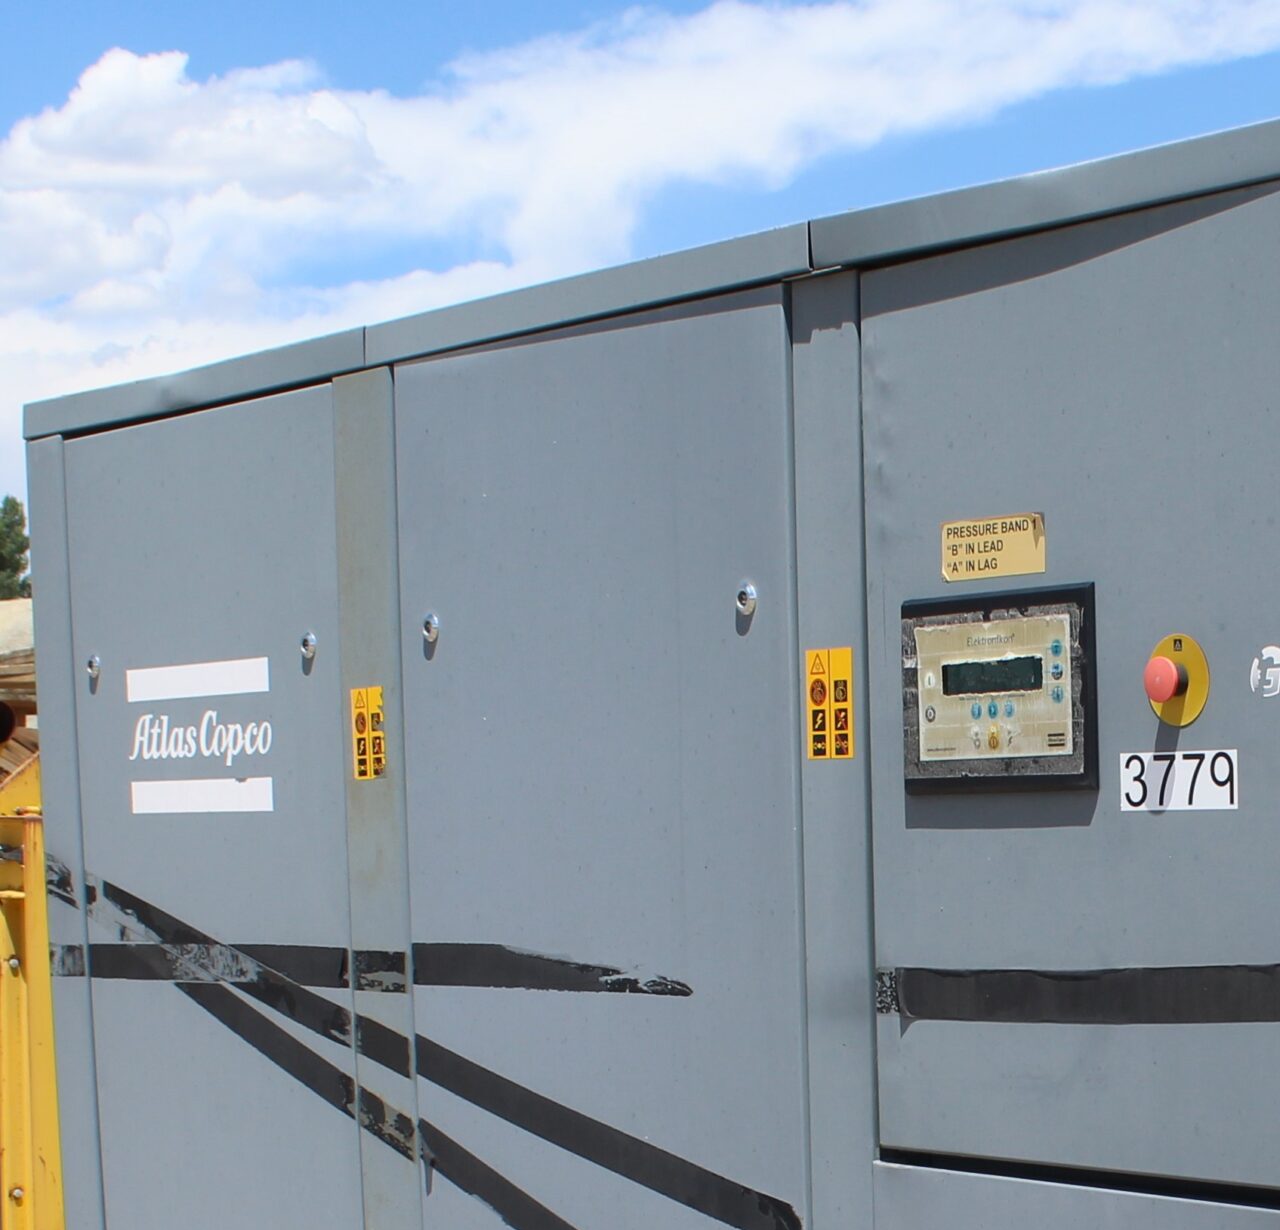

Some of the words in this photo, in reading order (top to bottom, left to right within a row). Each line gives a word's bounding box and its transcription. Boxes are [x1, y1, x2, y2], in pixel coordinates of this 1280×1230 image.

[946, 522, 999, 540] PRESSURE
[1001, 518, 1029, 534] BAND
[965, 542, 975, 555] IN
[977, 539, 1004, 554] LEAD
[965, 559, 975, 572] IN
[977, 557, 998, 571] LAG
[128, 713, 198, 761] Atlas
[200, 710, 273, 767] Copco
[1124, 751, 1235, 807] 3779
